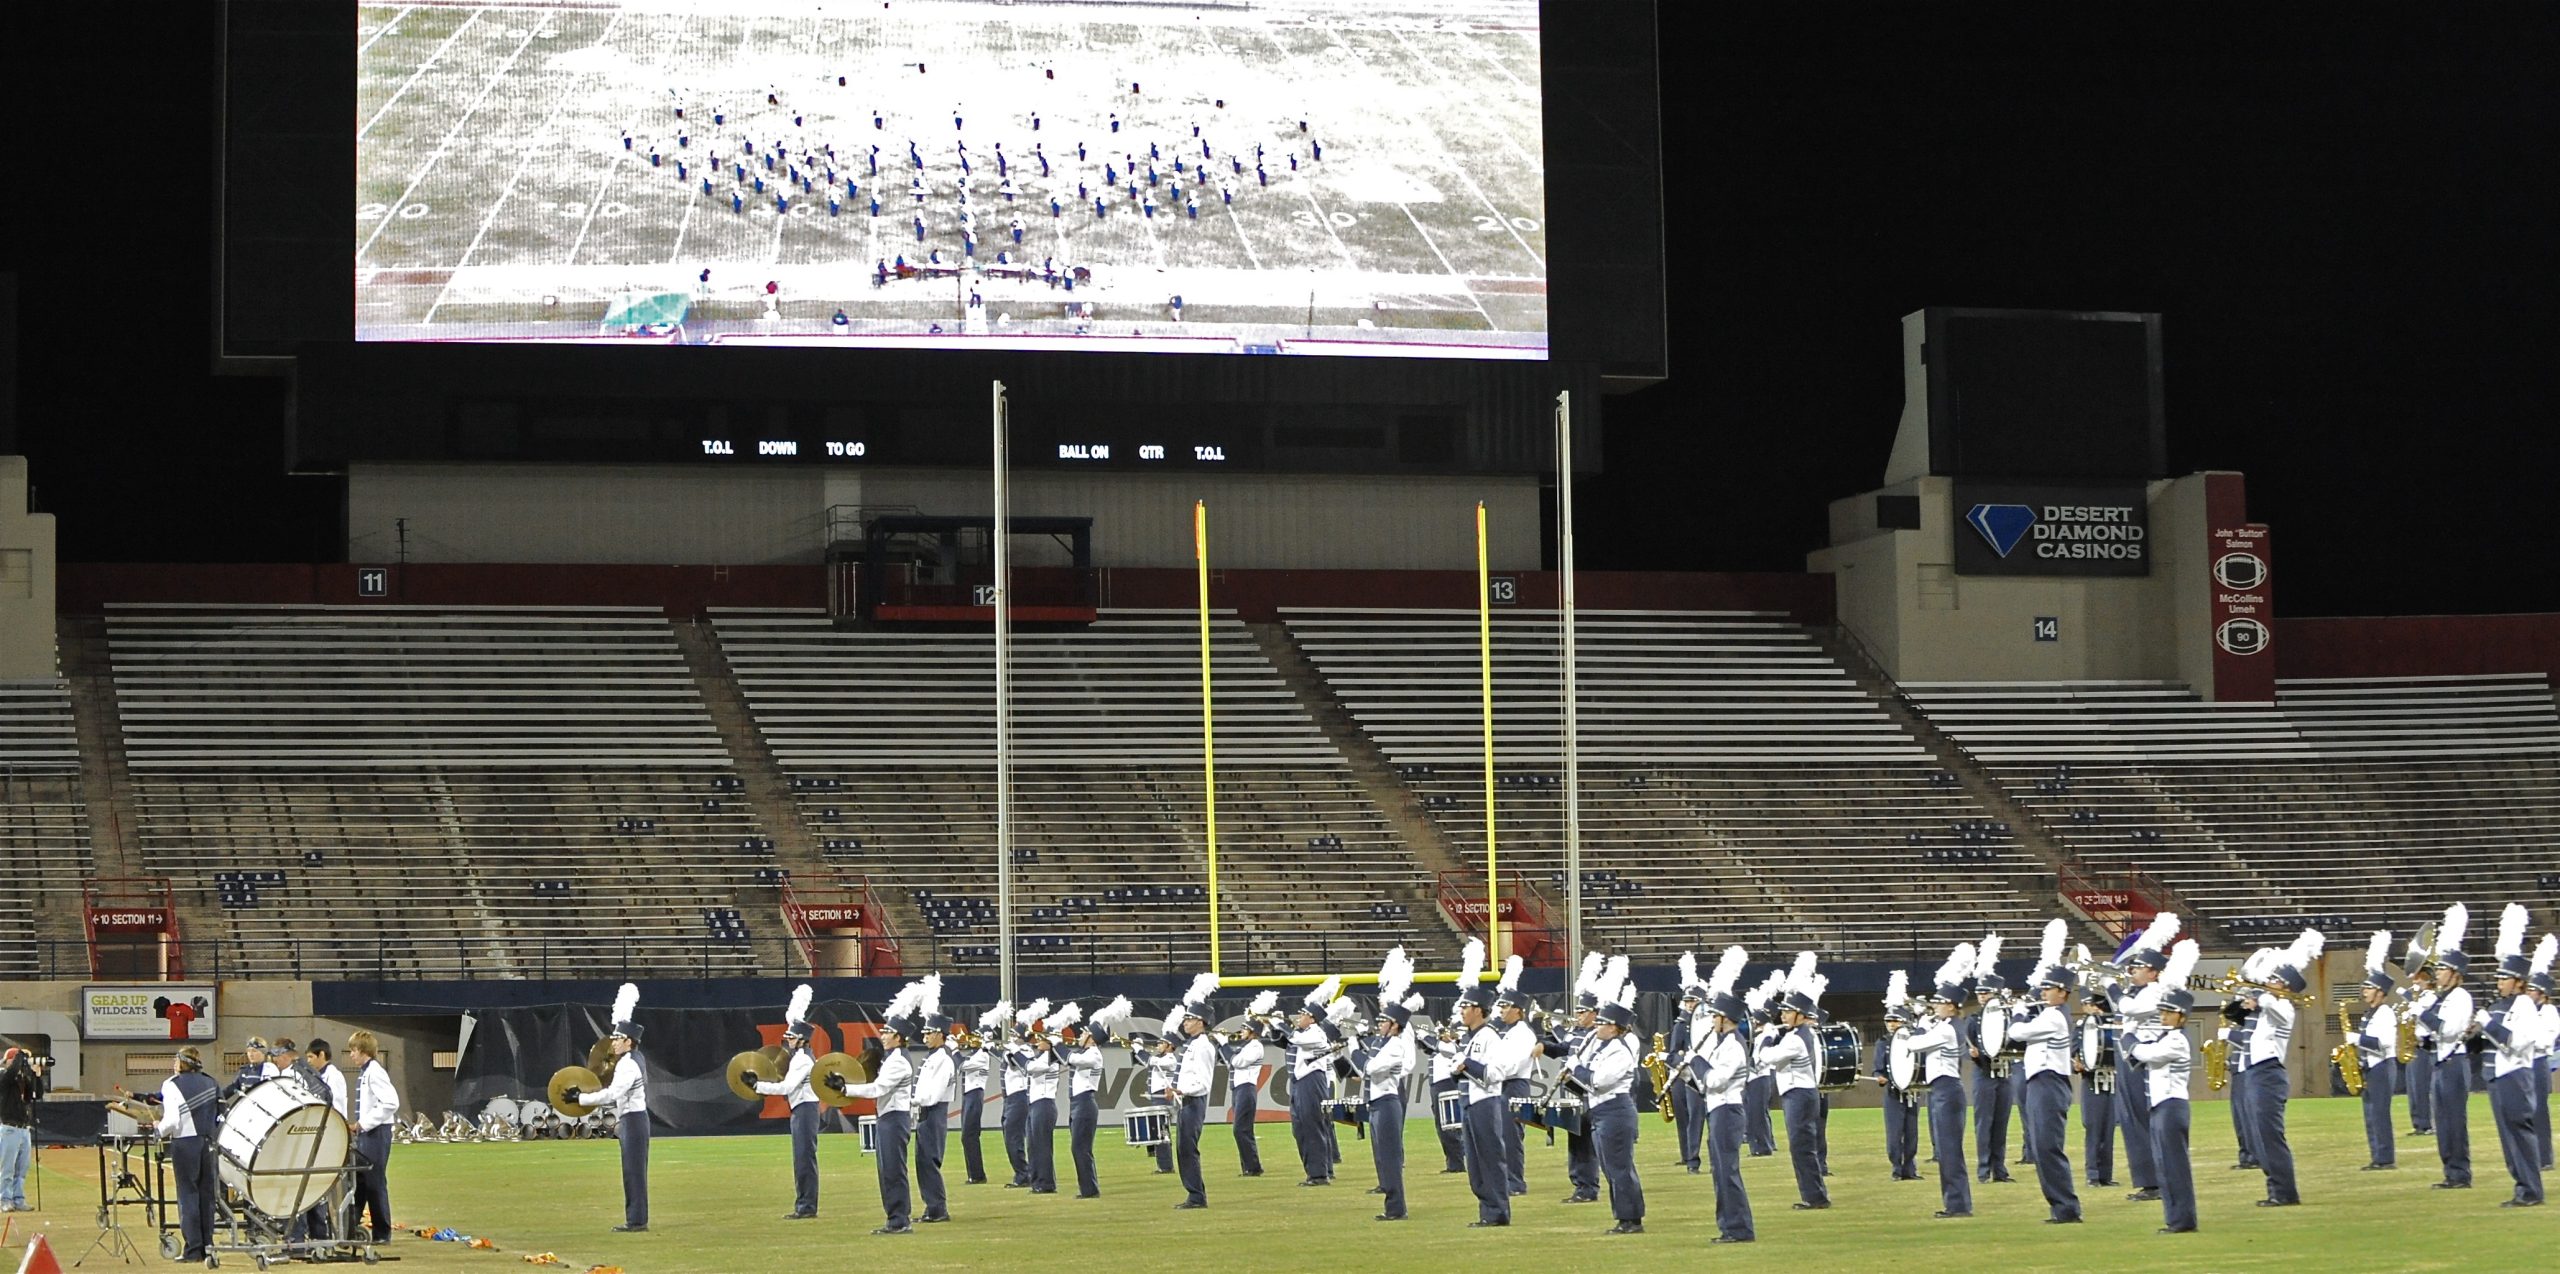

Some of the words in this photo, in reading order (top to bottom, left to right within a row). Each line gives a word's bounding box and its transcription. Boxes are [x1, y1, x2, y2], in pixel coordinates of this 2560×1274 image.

[759, 441, 797, 455] DOWN
[826, 442, 844, 456] TO
[846, 442, 865, 456] GO
[1059, 445, 1089, 459] BALL
[1091, 445, 1109, 459] ON
[1139, 445, 1164, 459] QTR
[2043, 505, 2133, 522] DESERT
[2033, 524, 2144, 541] DIAMOND
[2215, 528, 2233, 538] John
[2225, 539, 2253, 548] Salmon
[2036, 543, 2142, 559] CASINOS
[363, 573, 382, 591] 11
[975, 586, 996, 605] 12
[1491, 581, 1514, 599] 13
[2219, 594, 2264, 603] McCollins
[2228, 605, 2255, 614] Umeh
[2035, 620, 2057, 638] 14
[2236, 632, 2250, 642] 90
[808, 909, 841, 921] SECTION
[843, 909, 852, 920] 12
[1464, 903, 1490, 914] SECTIO
[100, 914, 109, 925] 10
[112, 914, 145, 925] SECTION
[147, 914, 155, 924] 11
[91, 995, 128, 1006] GEAR
[131, 995, 148, 1005] UP
[92, 1006, 148, 1015] WILDCATS
